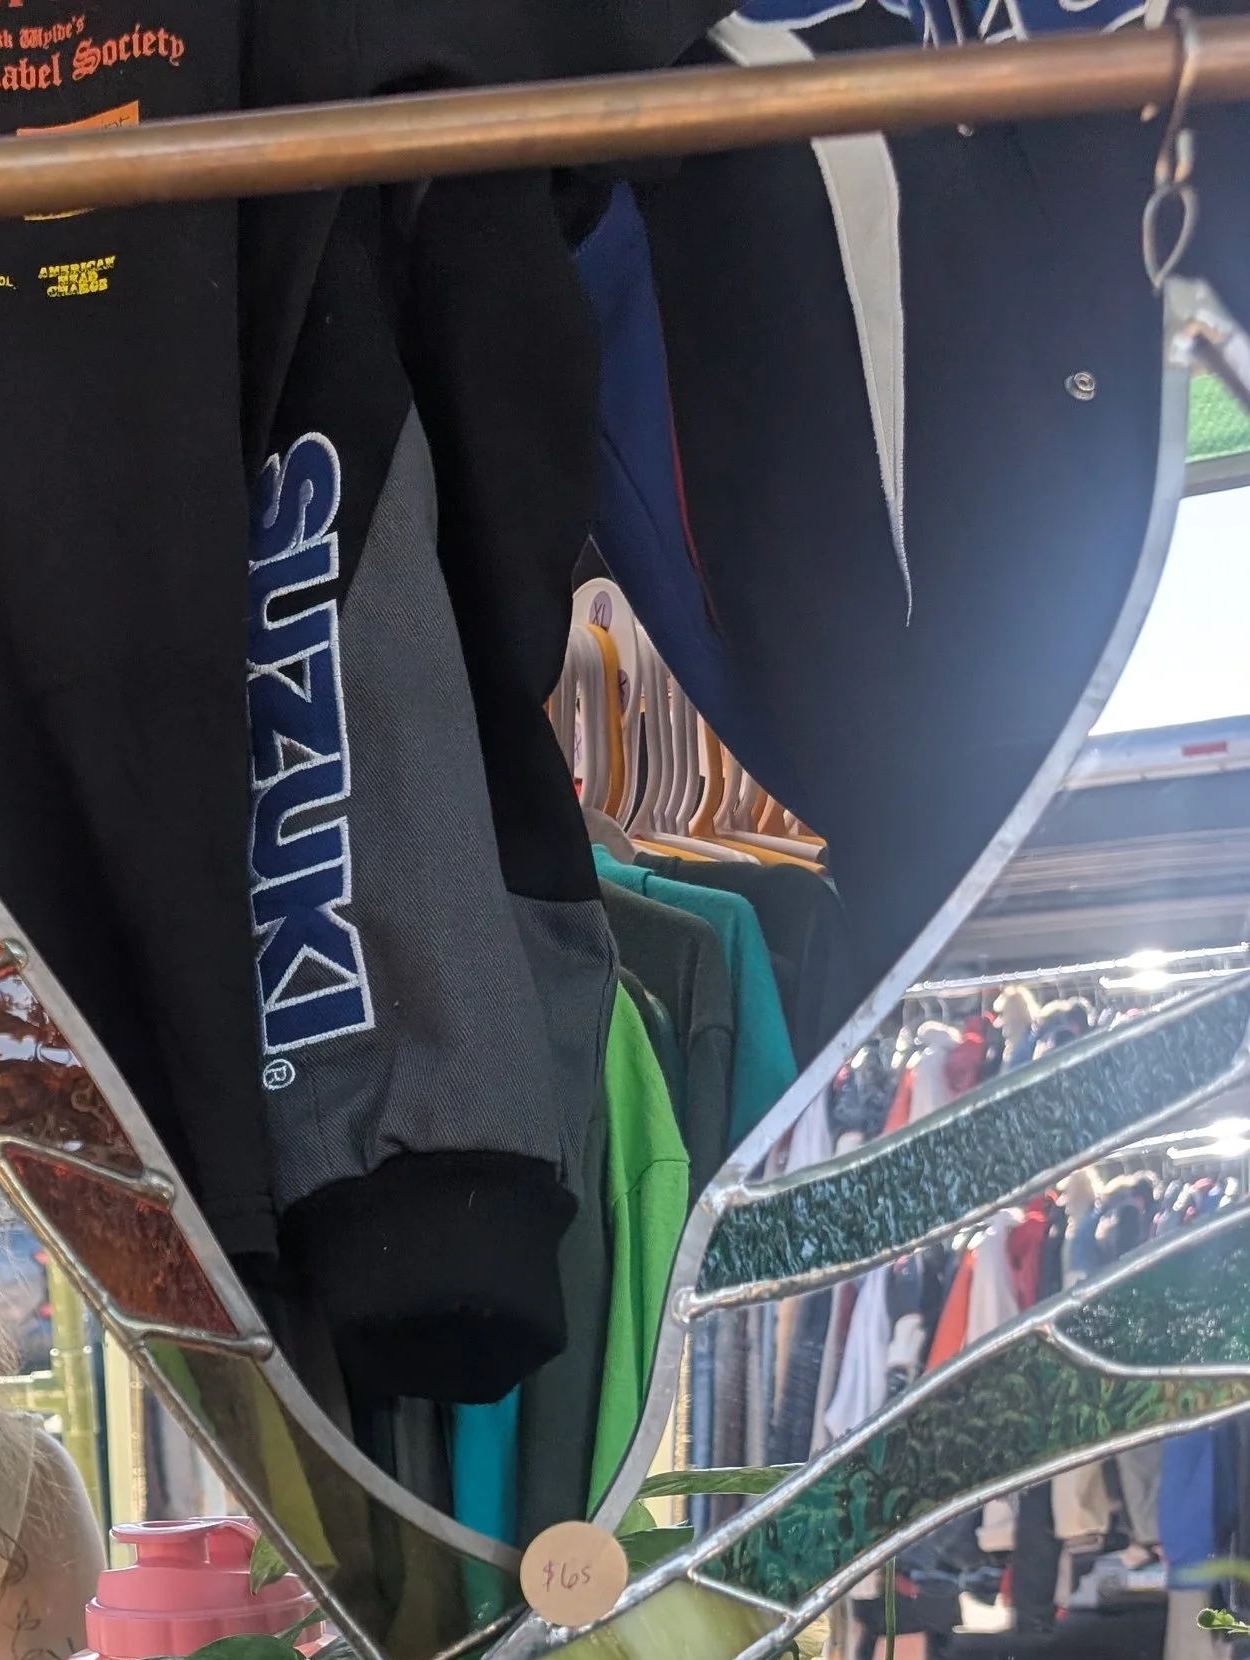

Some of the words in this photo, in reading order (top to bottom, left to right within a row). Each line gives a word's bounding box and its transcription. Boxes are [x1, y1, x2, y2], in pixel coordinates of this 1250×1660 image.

[72, 23, 185, 81] Society
[38, 255, 116, 279] AMERICAN
[246, 431, 376, 1055] SUZUKI
[542, 1559, 591, 1593] $65
